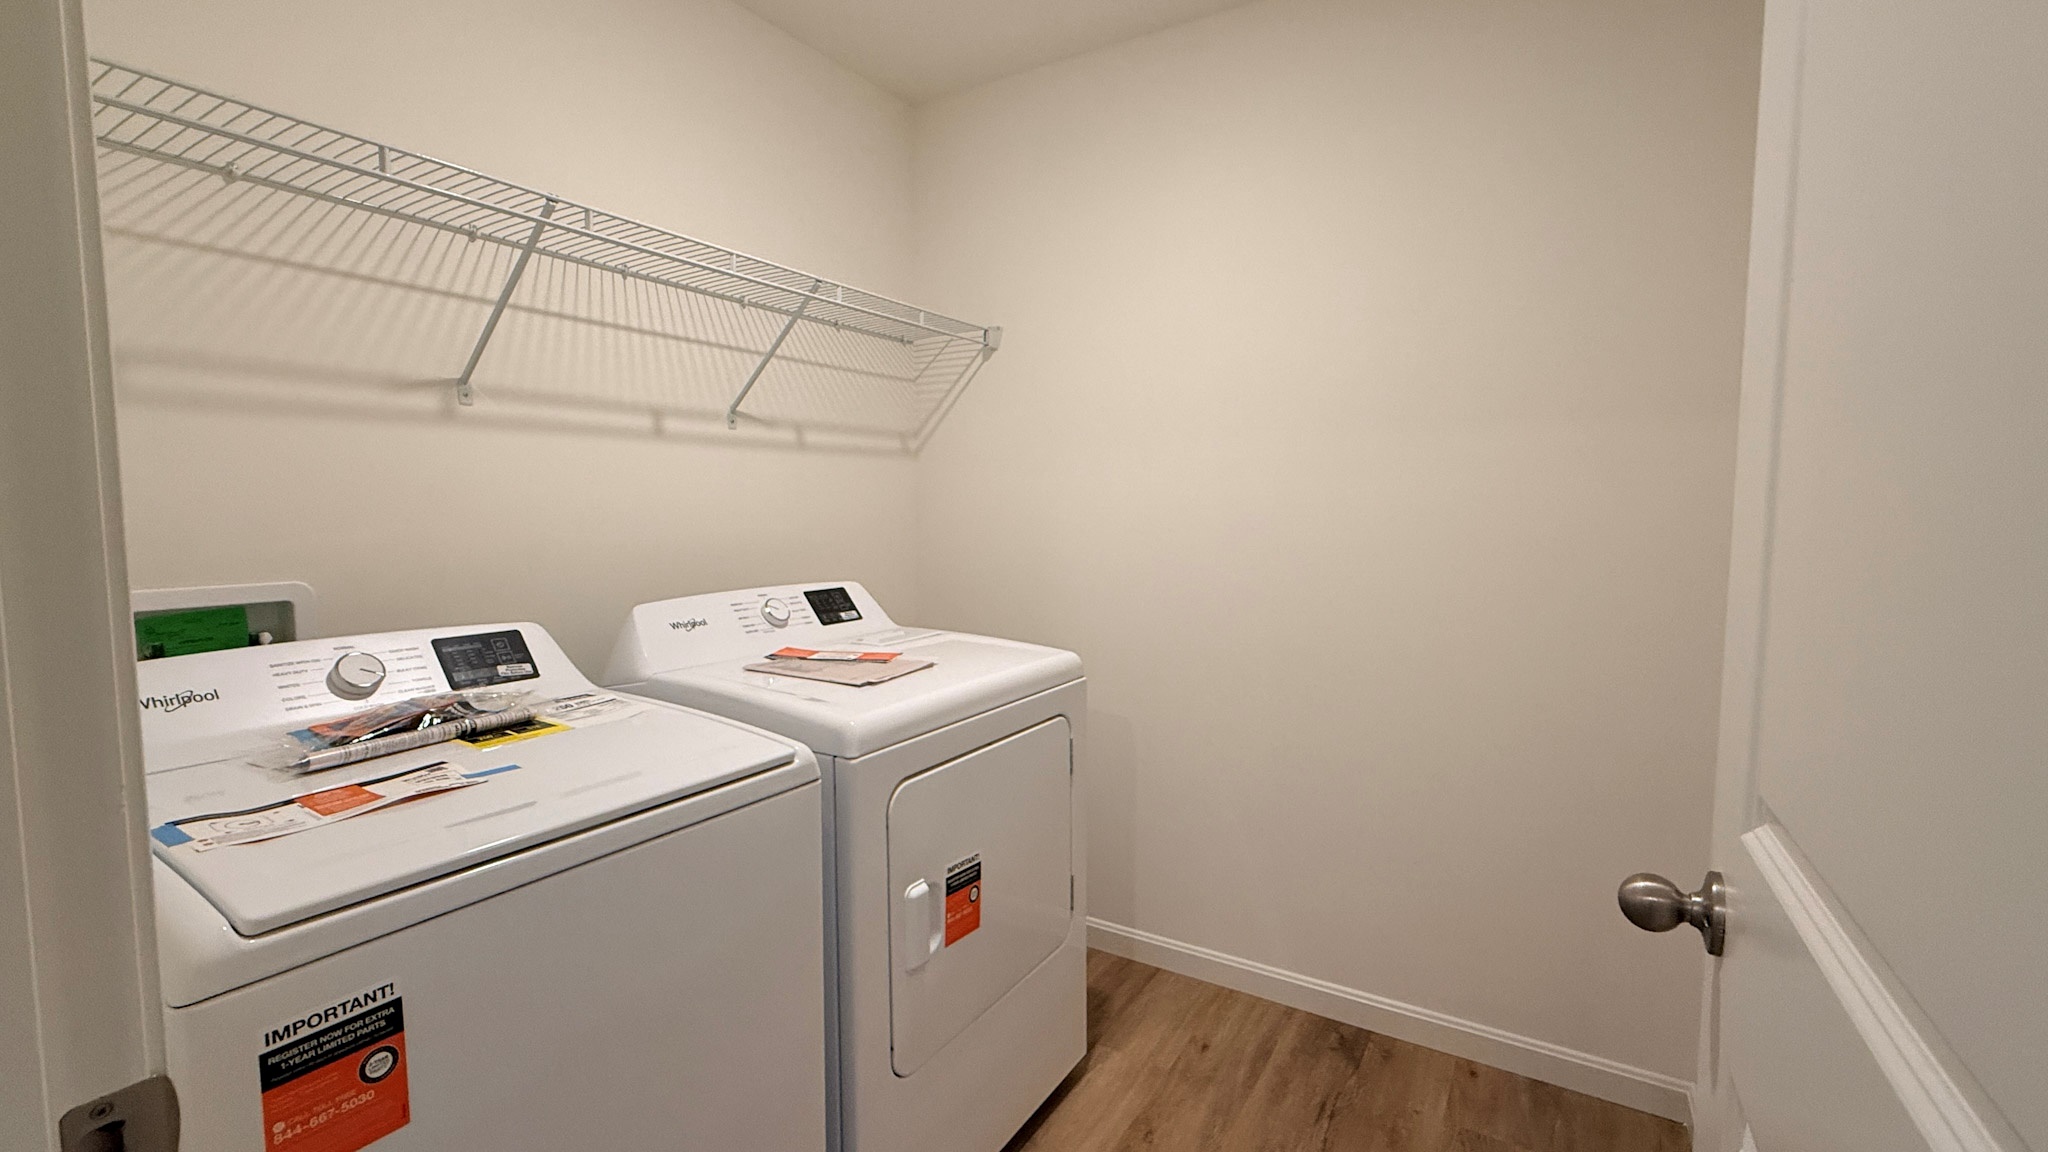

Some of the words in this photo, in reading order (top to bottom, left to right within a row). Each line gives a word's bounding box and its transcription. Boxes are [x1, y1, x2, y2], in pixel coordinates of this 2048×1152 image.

[669, 618, 708, 632] Whirlpool
[264, 982, 395, 1047] IMPORTANT!
[267, 1038, 318, 1066] REGISTER
[320, 1026, 343, 1044] NOW
[344, 1019, 364, 1033] FOR
[365, 1006, 395, 1025] EXTRA
[280, 1049, 316, 1070] 1-YEAR
[317, 1032, 355, 1055] LIMITED
[356, 1019, 386, 1037] PARTS
[273, 1089, 375, 1145] 844-667-5030
